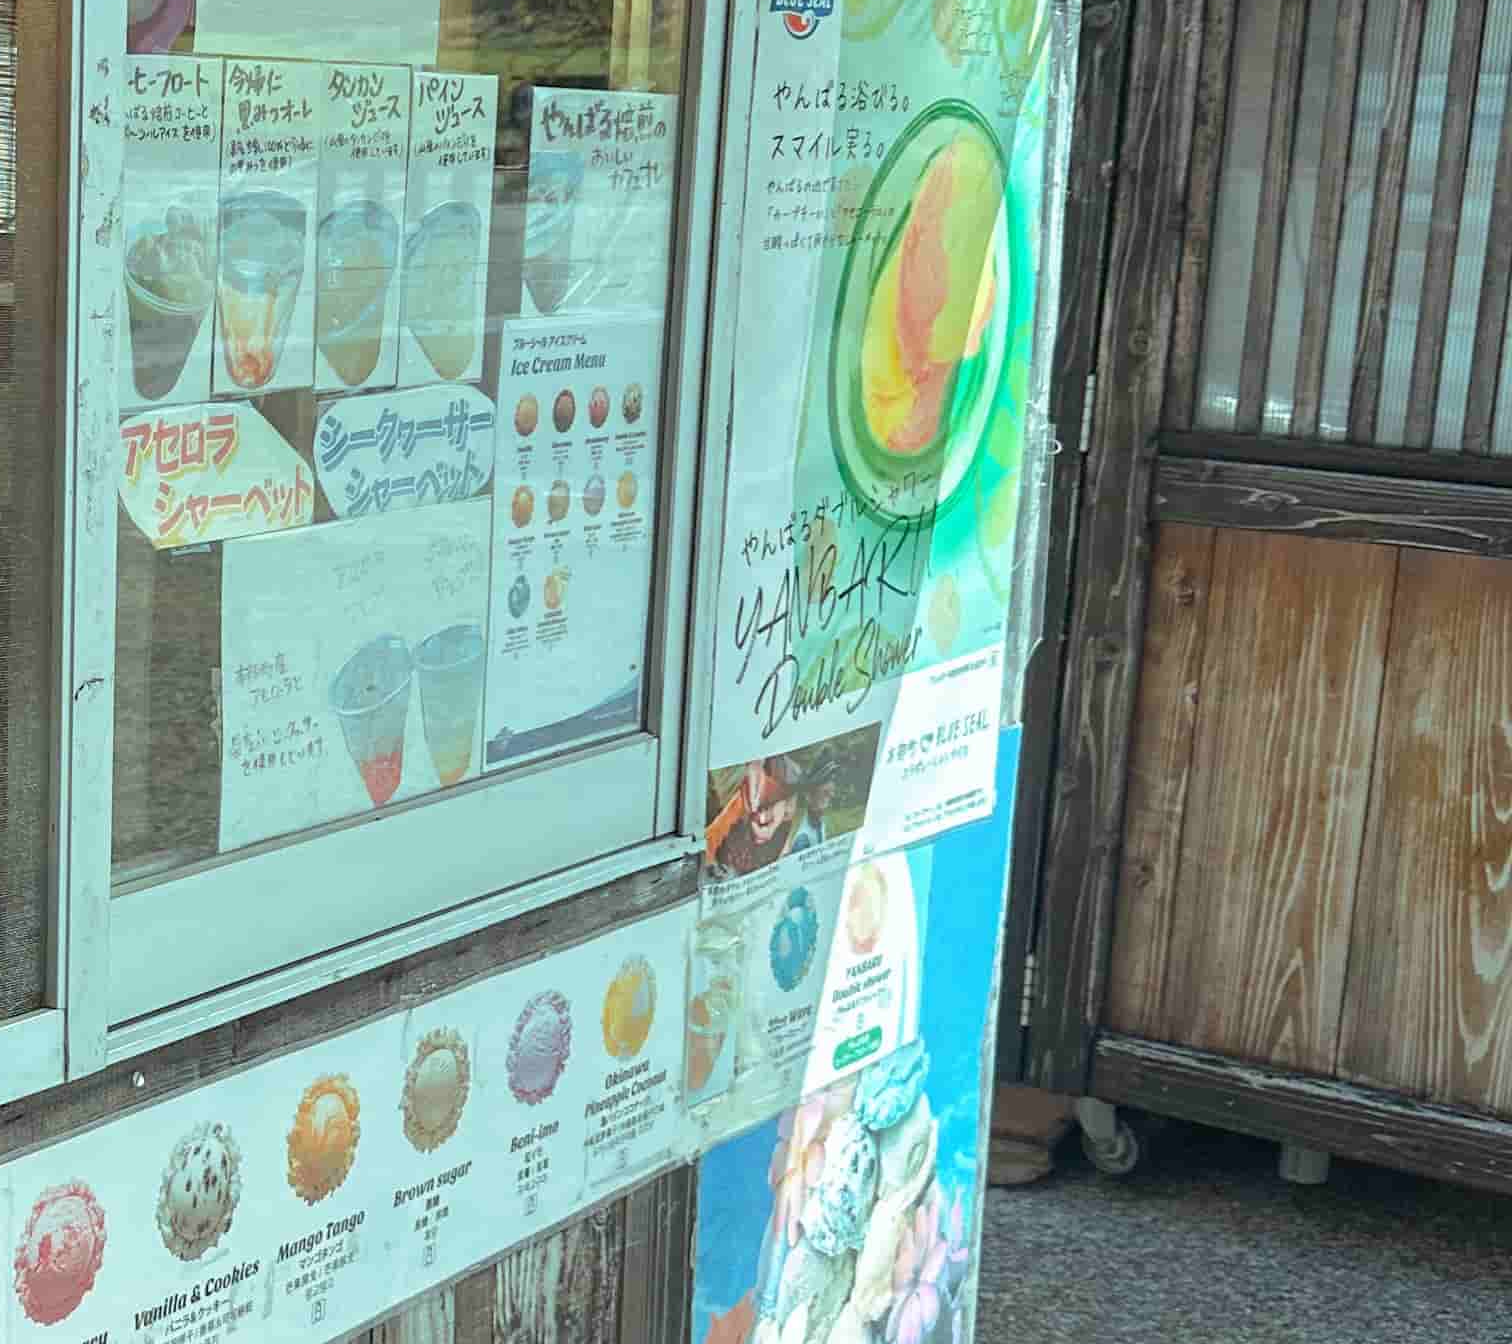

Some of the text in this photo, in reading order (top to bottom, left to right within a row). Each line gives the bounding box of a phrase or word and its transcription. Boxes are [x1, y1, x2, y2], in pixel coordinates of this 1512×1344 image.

[328, 69, 385, 102] タンカン
[418, 77, 465, 107] パイン
[351, 95, 401, 128] ジュース
[435, 96, 486, 134] ジュース
[511, 353, 608, 376] Ice Cream Menu
[121, 414, 240, 487] アセロラ
[153, 465, 314, 536] シャーベット
[345, 450, 486, 517] シャーベット
[755, 617, 922, 739] Double Shower
[393, 1159, 473, 1208] Brown sugar
[277, 1210, 366, 1264] Mango Tango
[135, 1293, 188, 1331] Vanilla
[190, 1284, 201, 1304] &
[204, 1259, 260, 1296] Cookies
